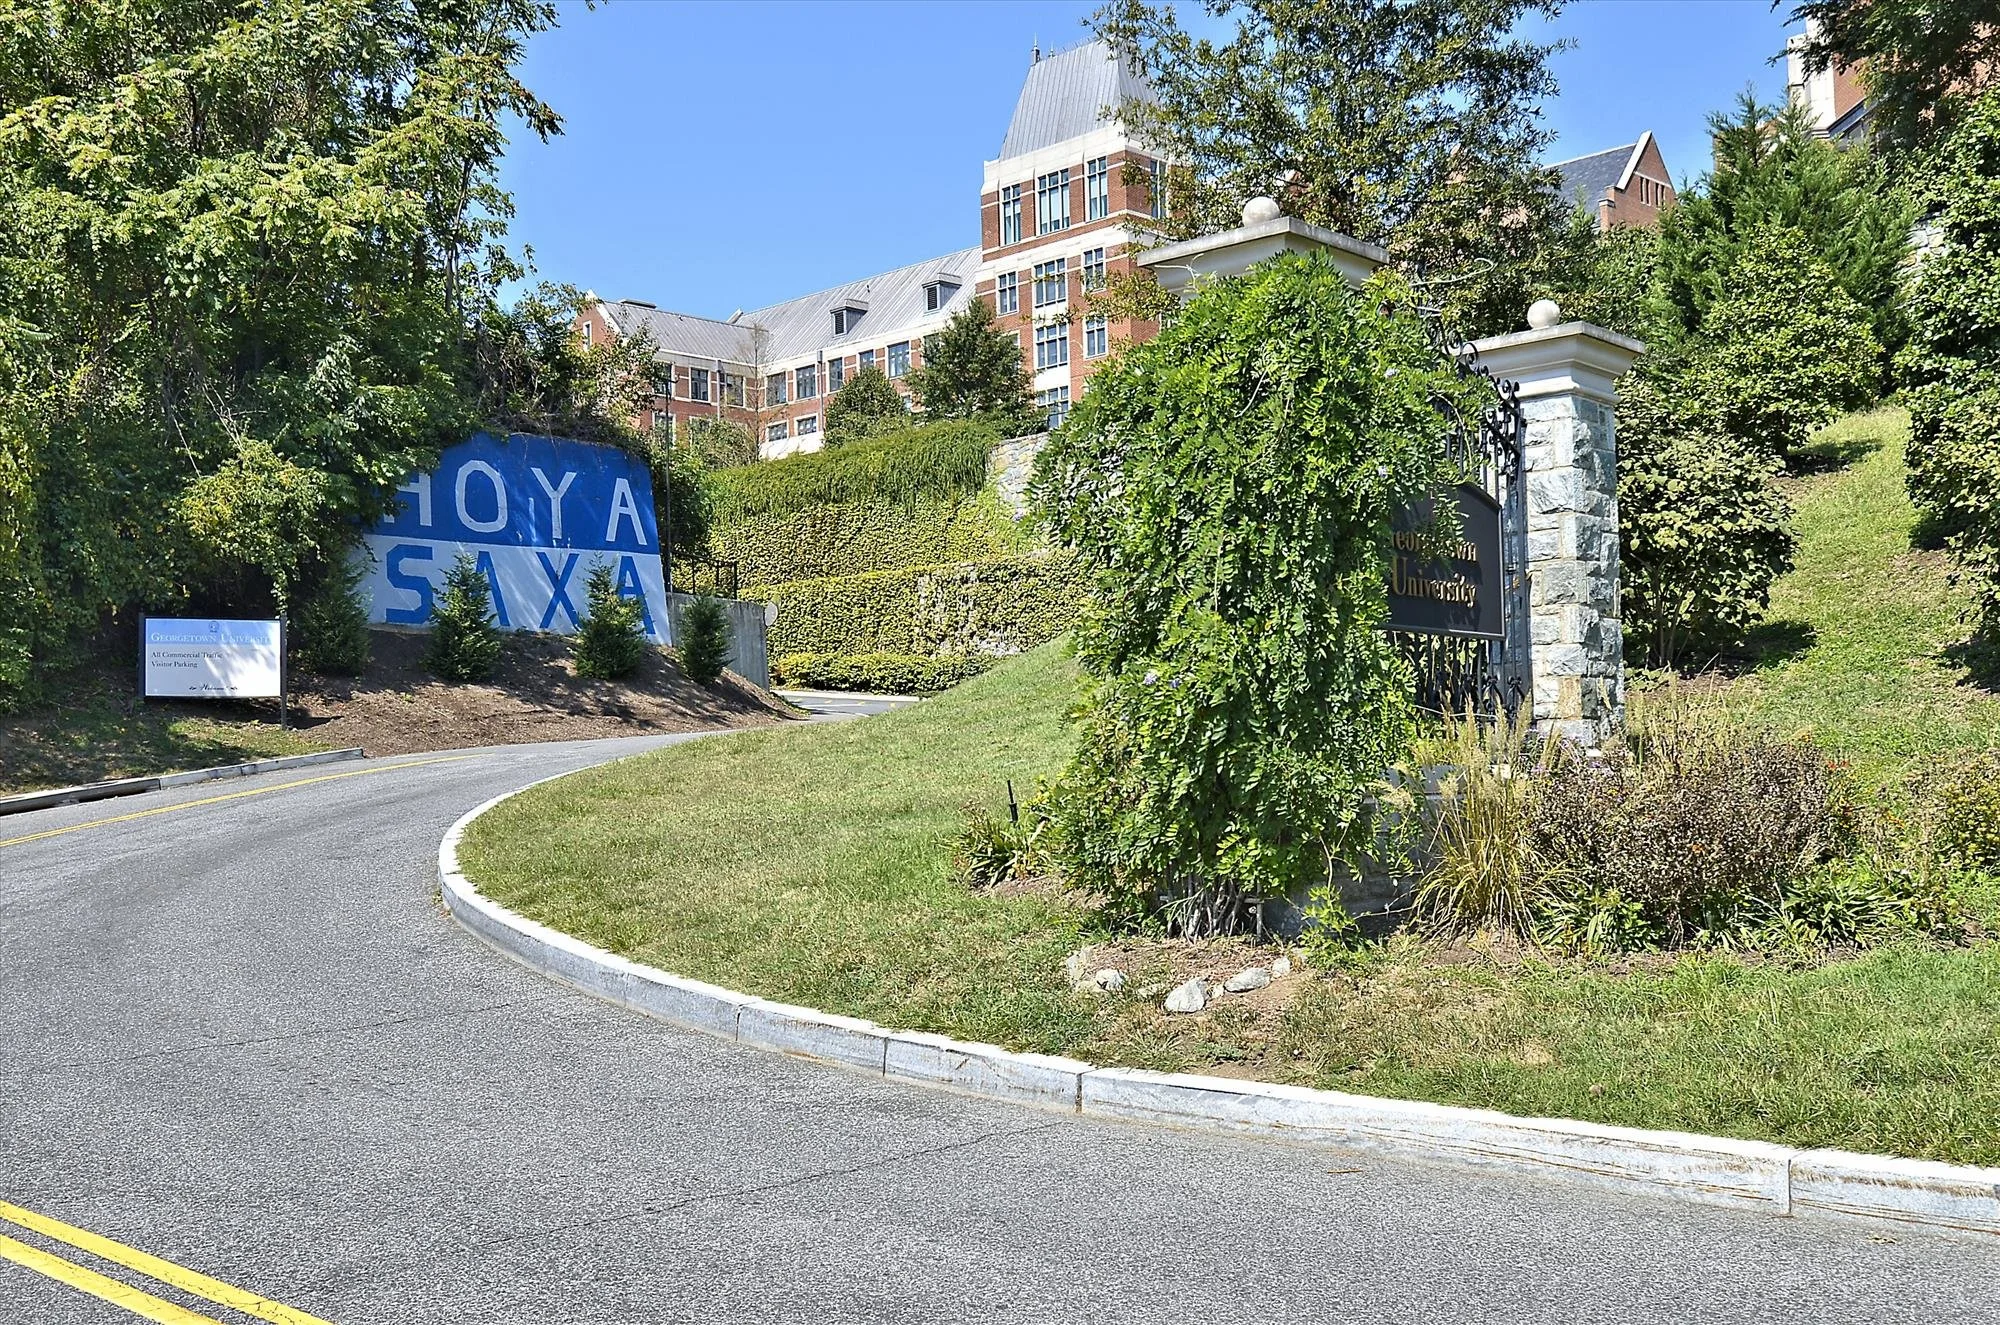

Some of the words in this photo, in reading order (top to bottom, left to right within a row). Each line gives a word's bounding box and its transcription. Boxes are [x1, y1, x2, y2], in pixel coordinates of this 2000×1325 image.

[384, 459, 648, 546] HOYA
[385, 543, 656, 635] SAXA
[1391, 555, 1477, 608] University
[151, 632, 216, 642] GEORGETOWN
[221, 633, 270, 644] UNIVERSIT
[151, 651, 161, 659] All
[162, 651, 200, 659] Commercial
[201, 651, 223, 659] Traffic
[174, 661, 198, 669] Parking
